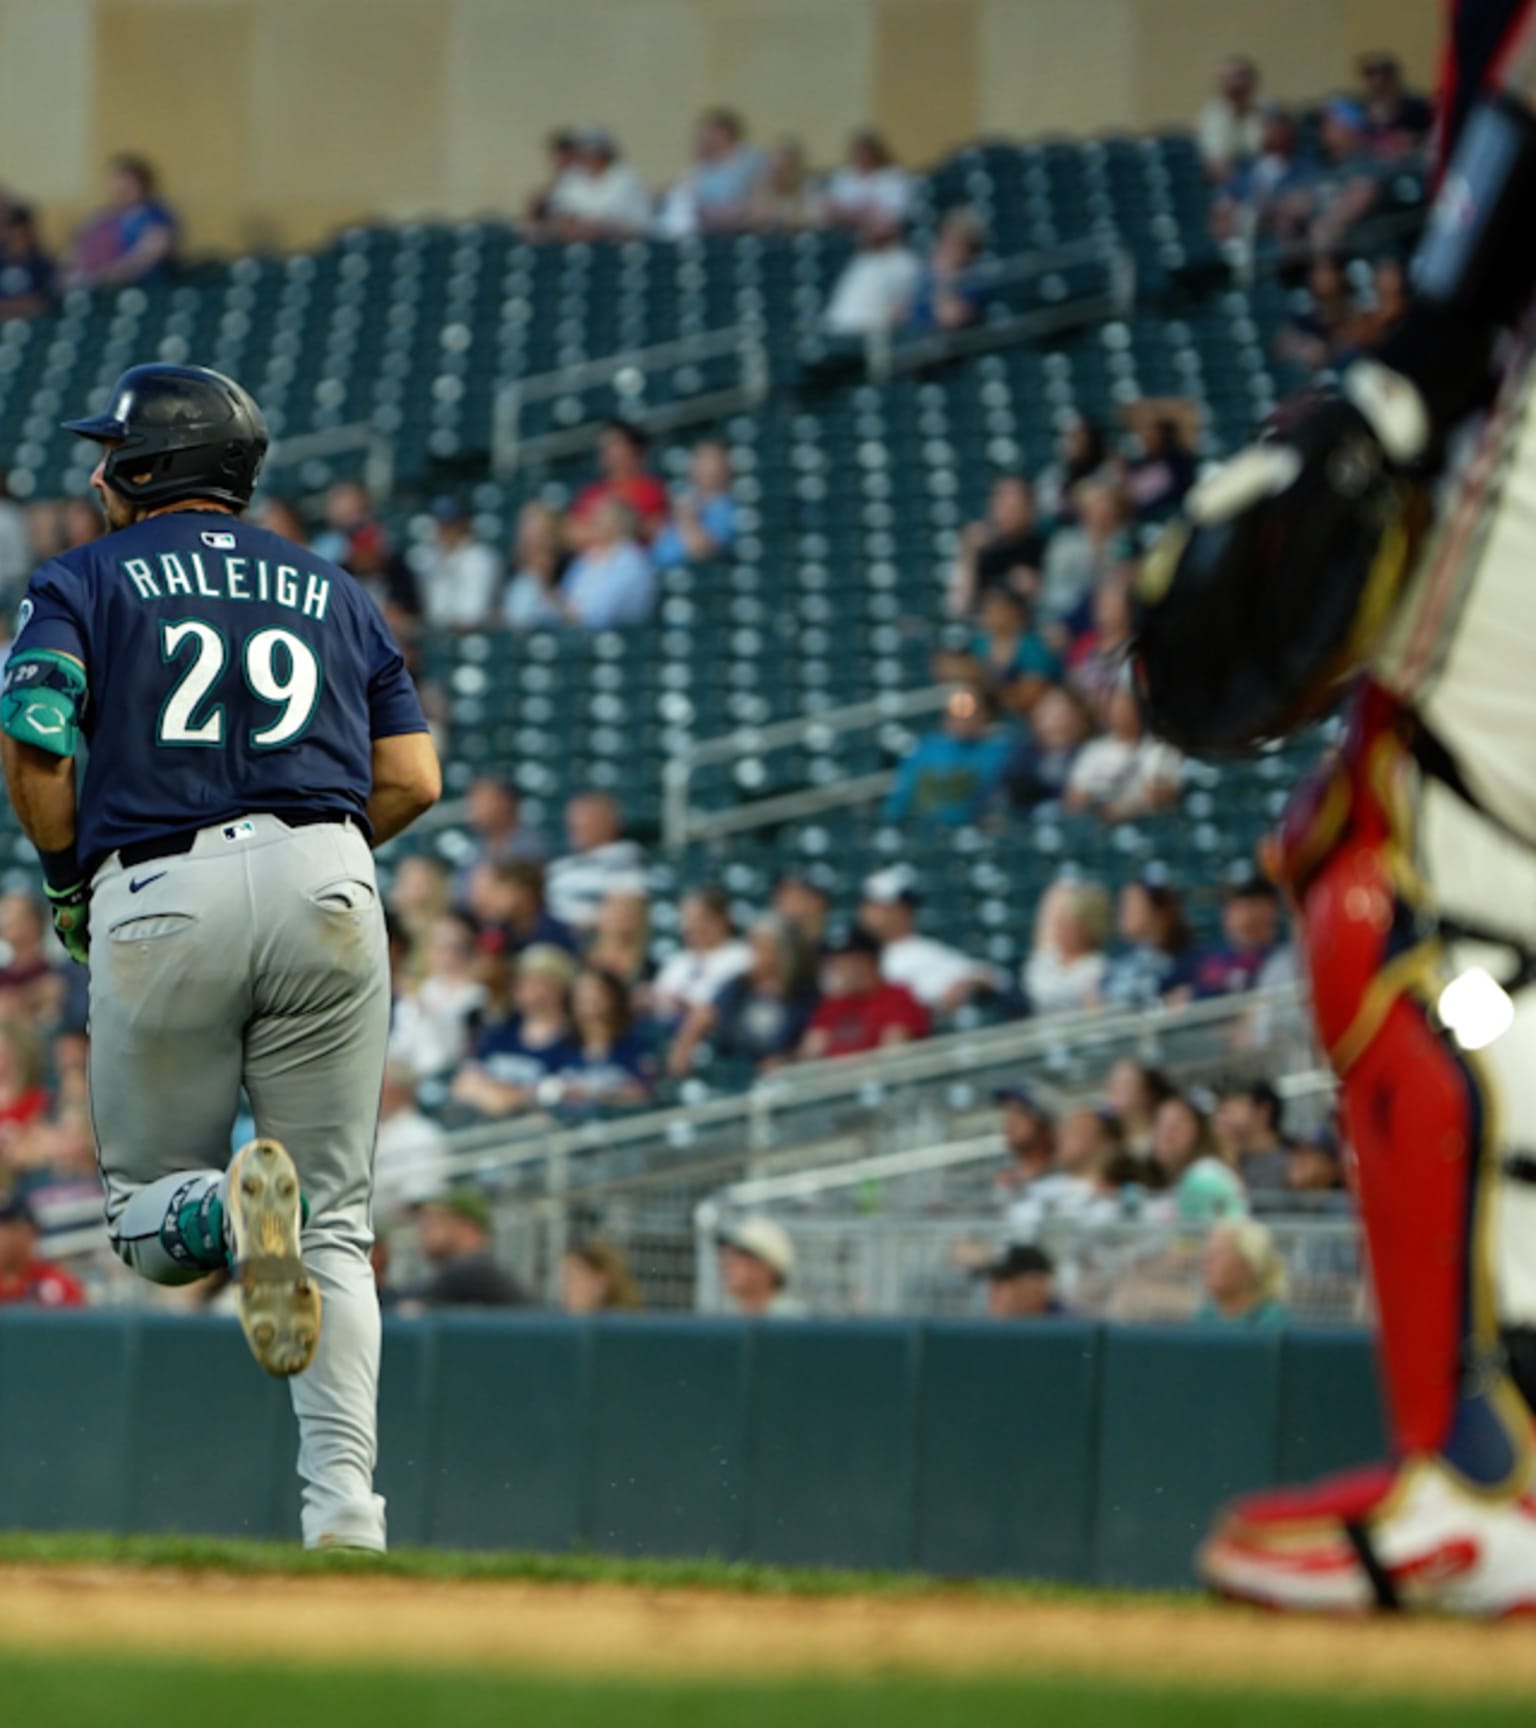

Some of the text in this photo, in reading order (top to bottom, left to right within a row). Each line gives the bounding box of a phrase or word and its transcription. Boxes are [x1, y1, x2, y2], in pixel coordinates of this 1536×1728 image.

[123, 551, 331, 622] RALEIGH
[14, 663, 39, 682] 29
[155, 616, 322, 748] 29
